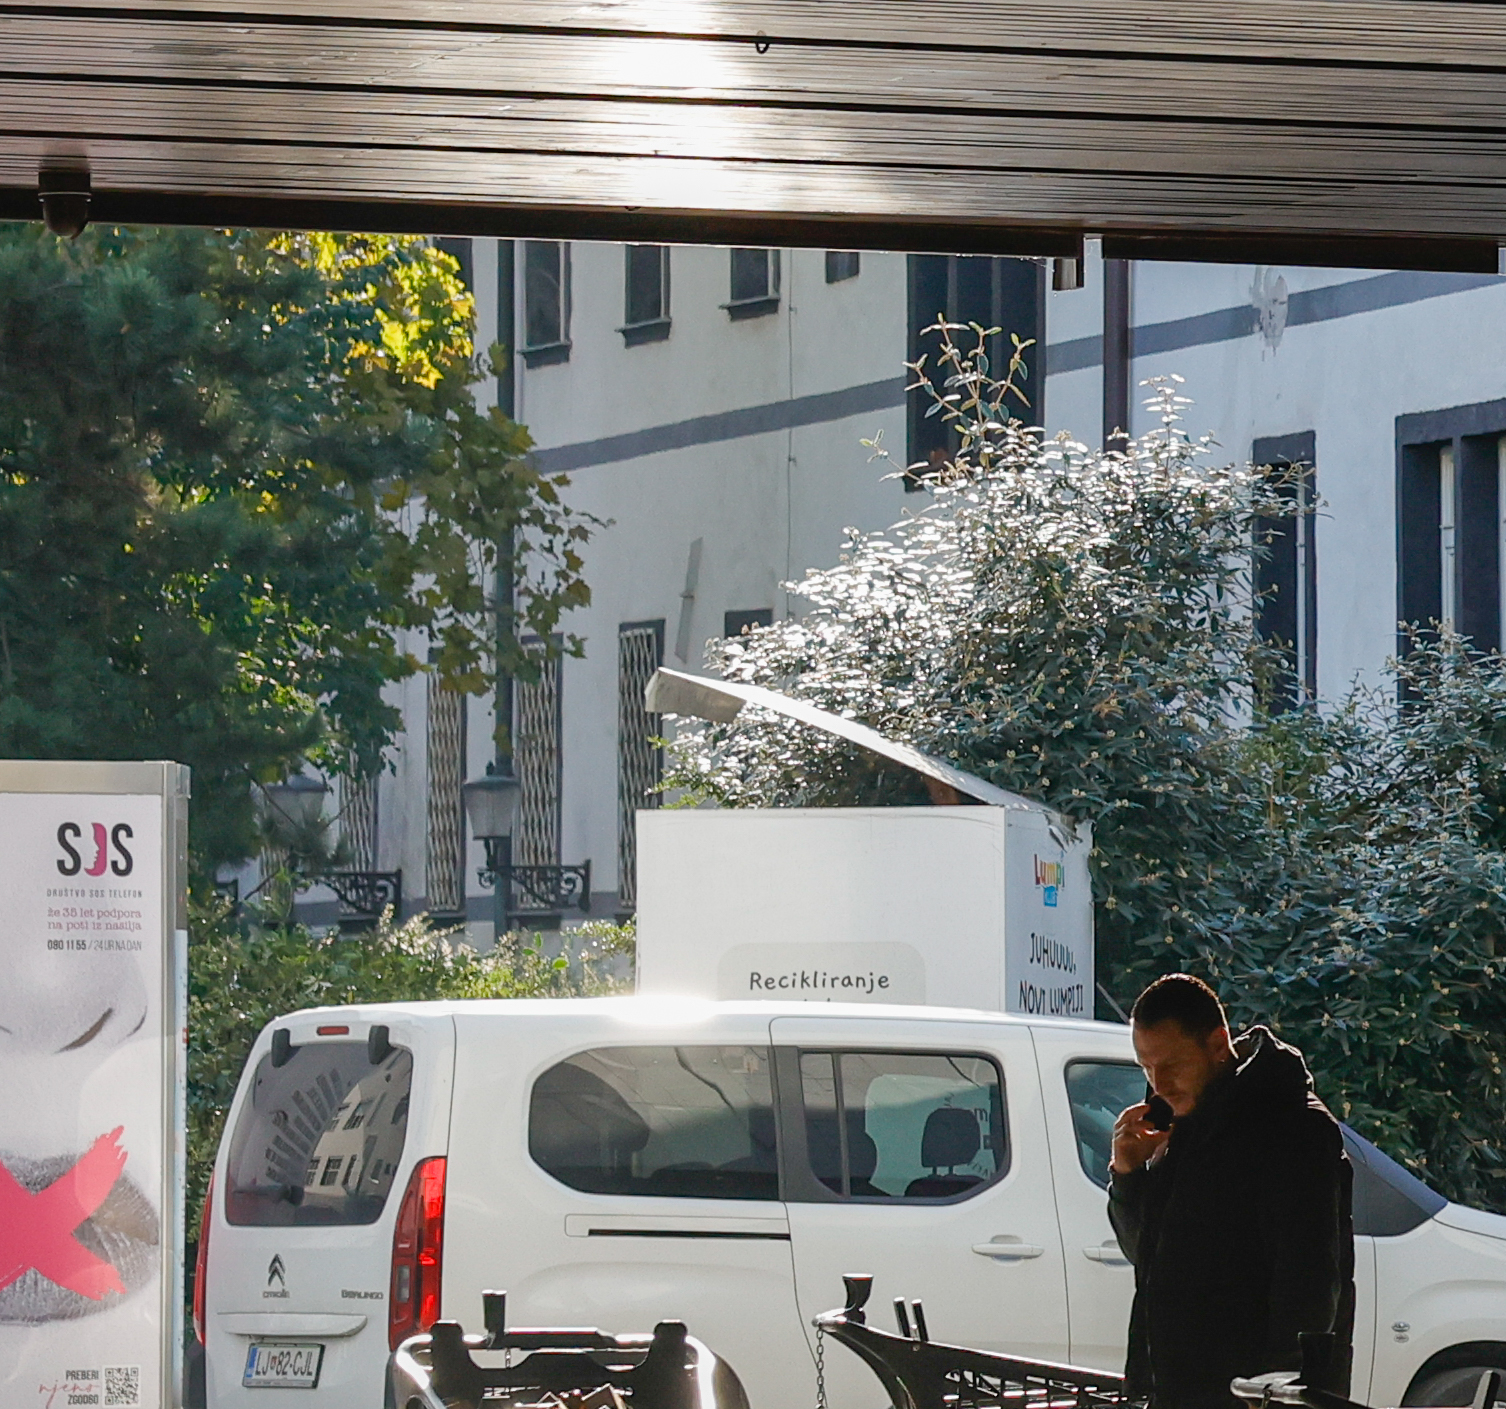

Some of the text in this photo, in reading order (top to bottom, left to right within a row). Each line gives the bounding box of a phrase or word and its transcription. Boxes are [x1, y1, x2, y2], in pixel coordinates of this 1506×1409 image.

[56, 822, 134, 877] SOS
[47, 888, 142, 898] DRUŠTVO SOS TELEFON
[80, 907, 95, 918] let
[97, 908, 142, 920] podpora
[48, 921, 63, 930] na
[105, 921, 142, 932] nasilja
[749, 970, 890, 994] Recikliranje
[1019, 980, 1046, 1016] NOVI
[65, 1369, 100, 1380] PREBERI
